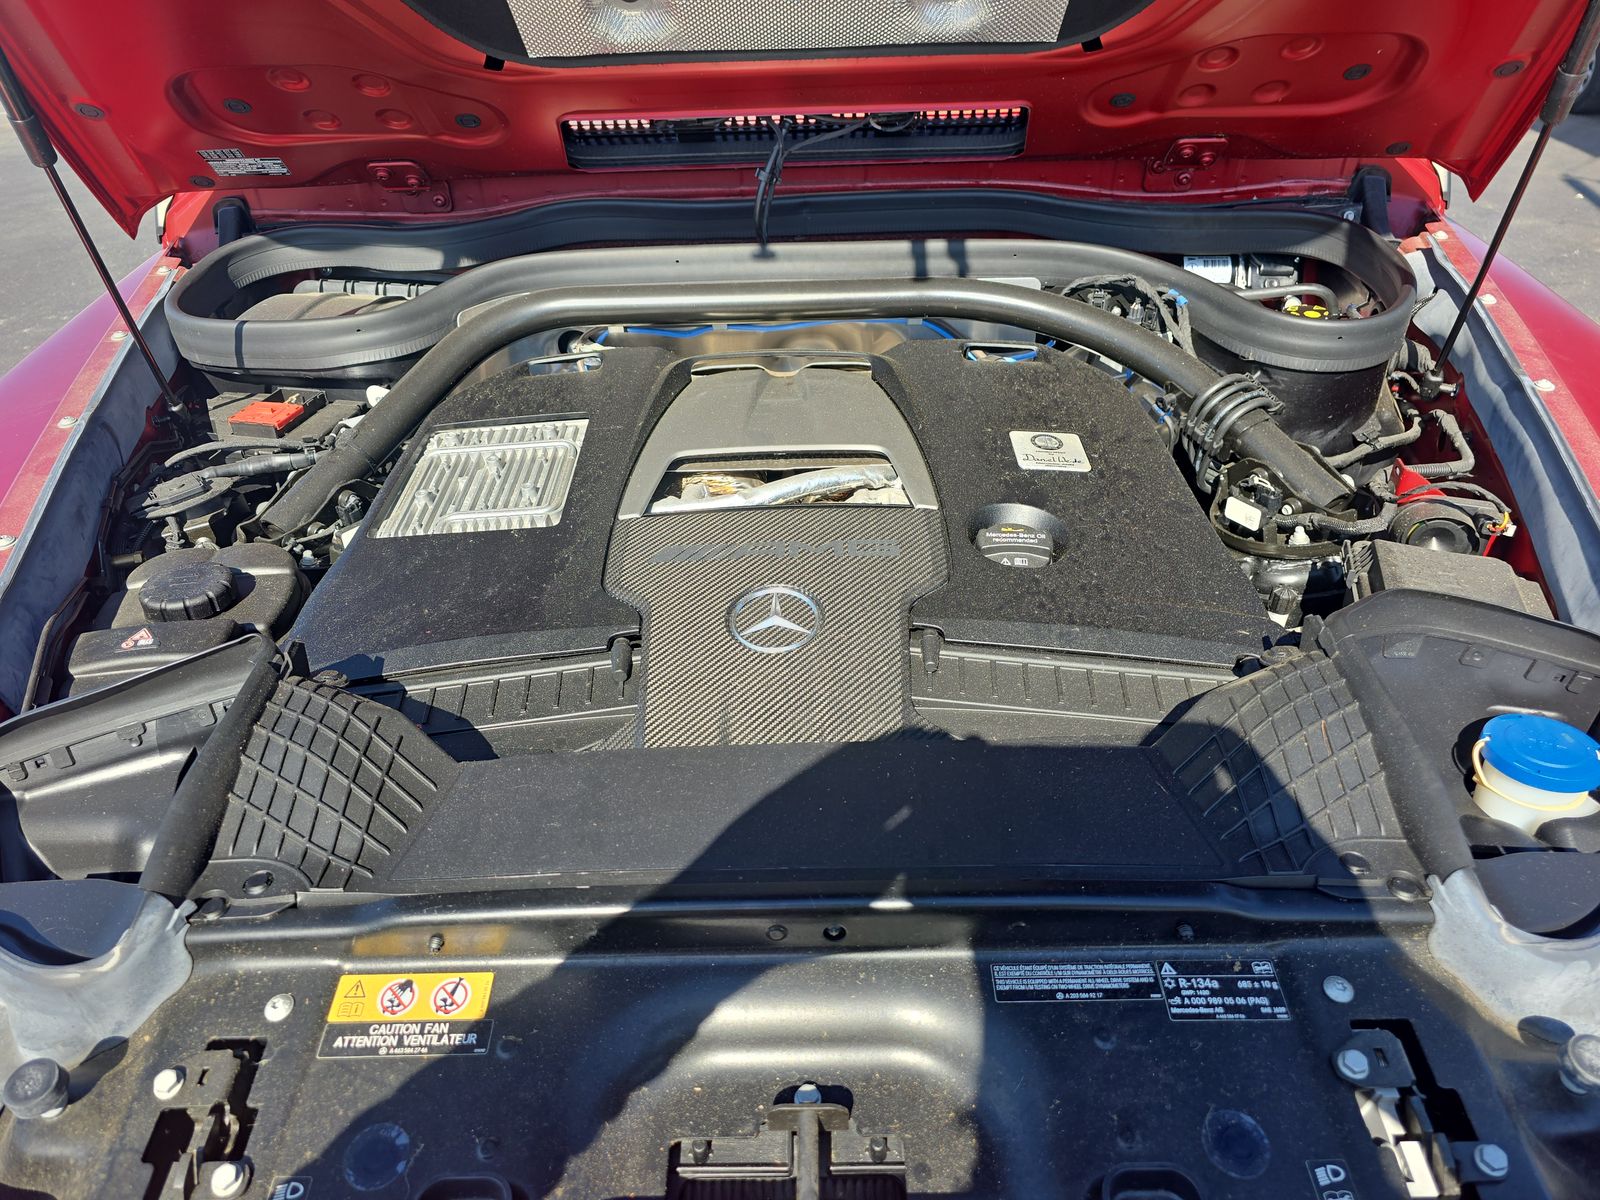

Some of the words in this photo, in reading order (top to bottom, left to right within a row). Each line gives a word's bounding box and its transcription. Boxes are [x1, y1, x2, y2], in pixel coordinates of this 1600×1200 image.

[730, 539, 900, 560] AMG
[1178, 978, 1220, 988] R-134a
[1237, 980, 1253, 989] 685
[1261, 980, 1271, 988] 10
[1272, 981, 1279, 990] g
[1184, 997, 1190, 1005] A
[1191, 997, 1206, 1005] 000
[1207, 996, 1223, 1005] 989
[1223, 996, 1235, 1005] 05
[1235, 996, 1247, 1005] 06
[1247, 996, 1269, 1006] (PAG)
[369, 1023, 422, 1036] CAUTION
[424, 1022, 450, 1034] FAN
[332, 1035, 400, 1048] ATTENTION
[403, 1033, 478, 1047] VENTILATEUR
